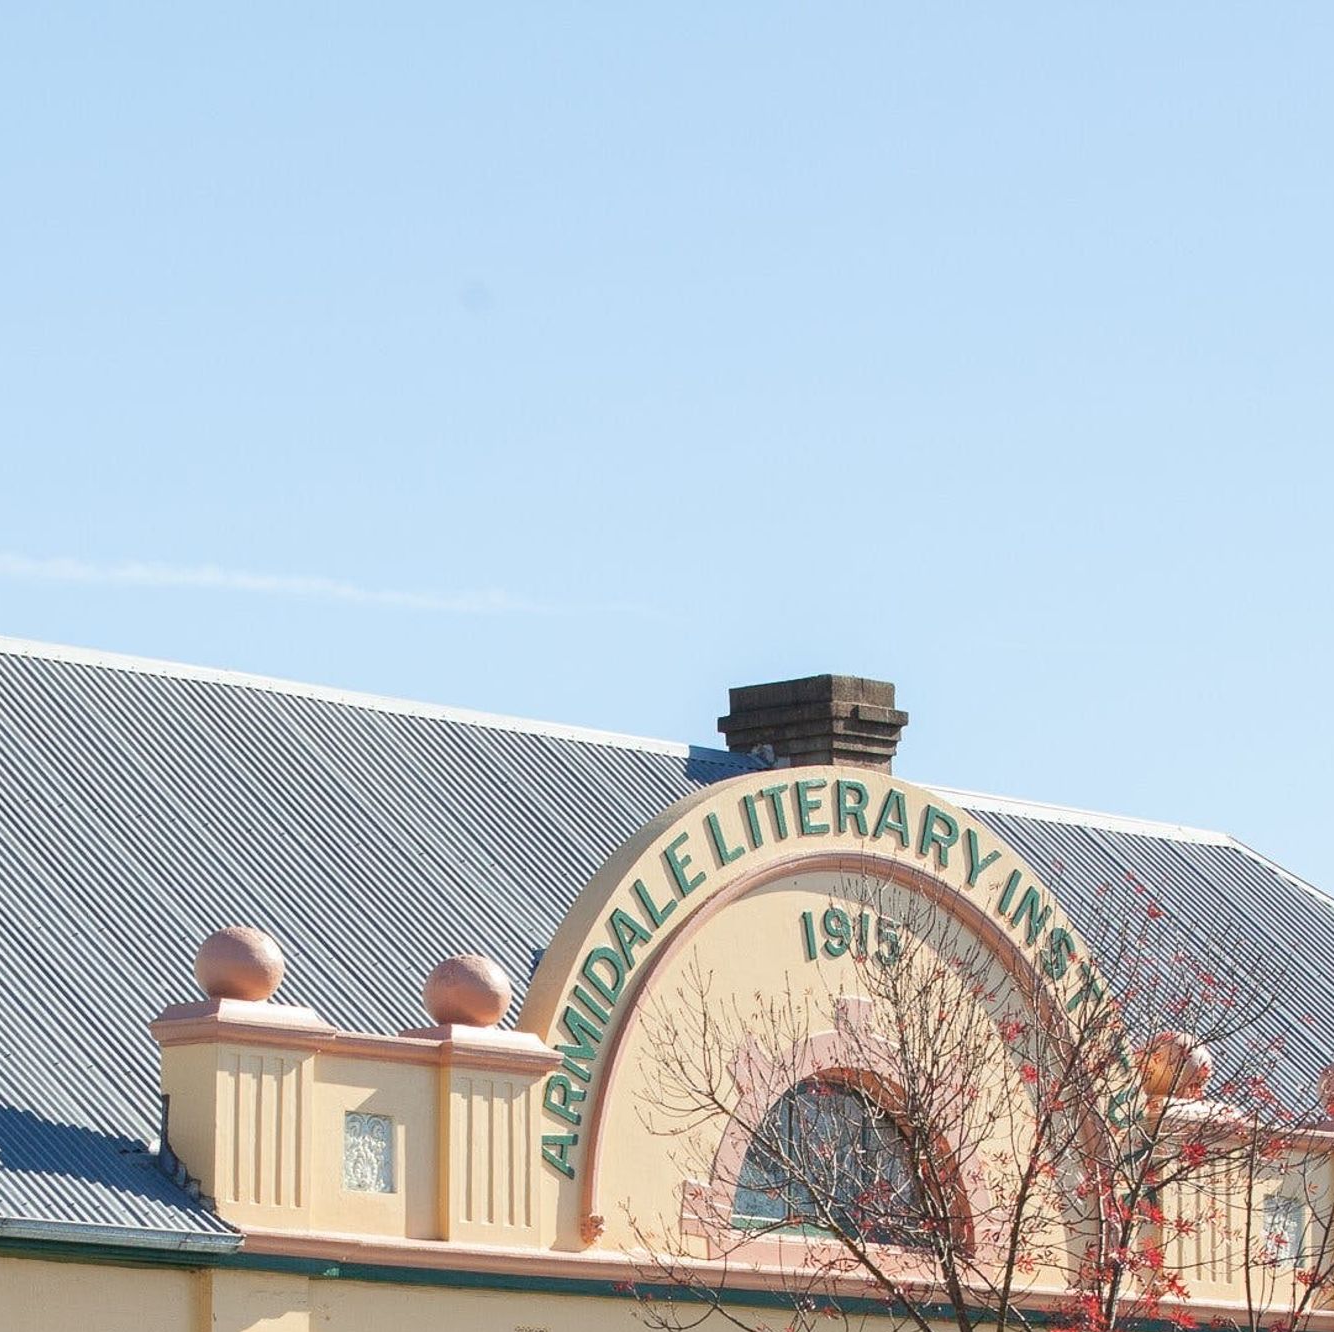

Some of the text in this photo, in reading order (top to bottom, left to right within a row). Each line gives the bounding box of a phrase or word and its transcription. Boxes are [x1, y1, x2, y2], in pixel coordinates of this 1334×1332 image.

[541, 831, 707, 1180] ARMIDALE
[706, 778, 1002, 888] LITERARY
[801, 905, 900, 966] 1915
